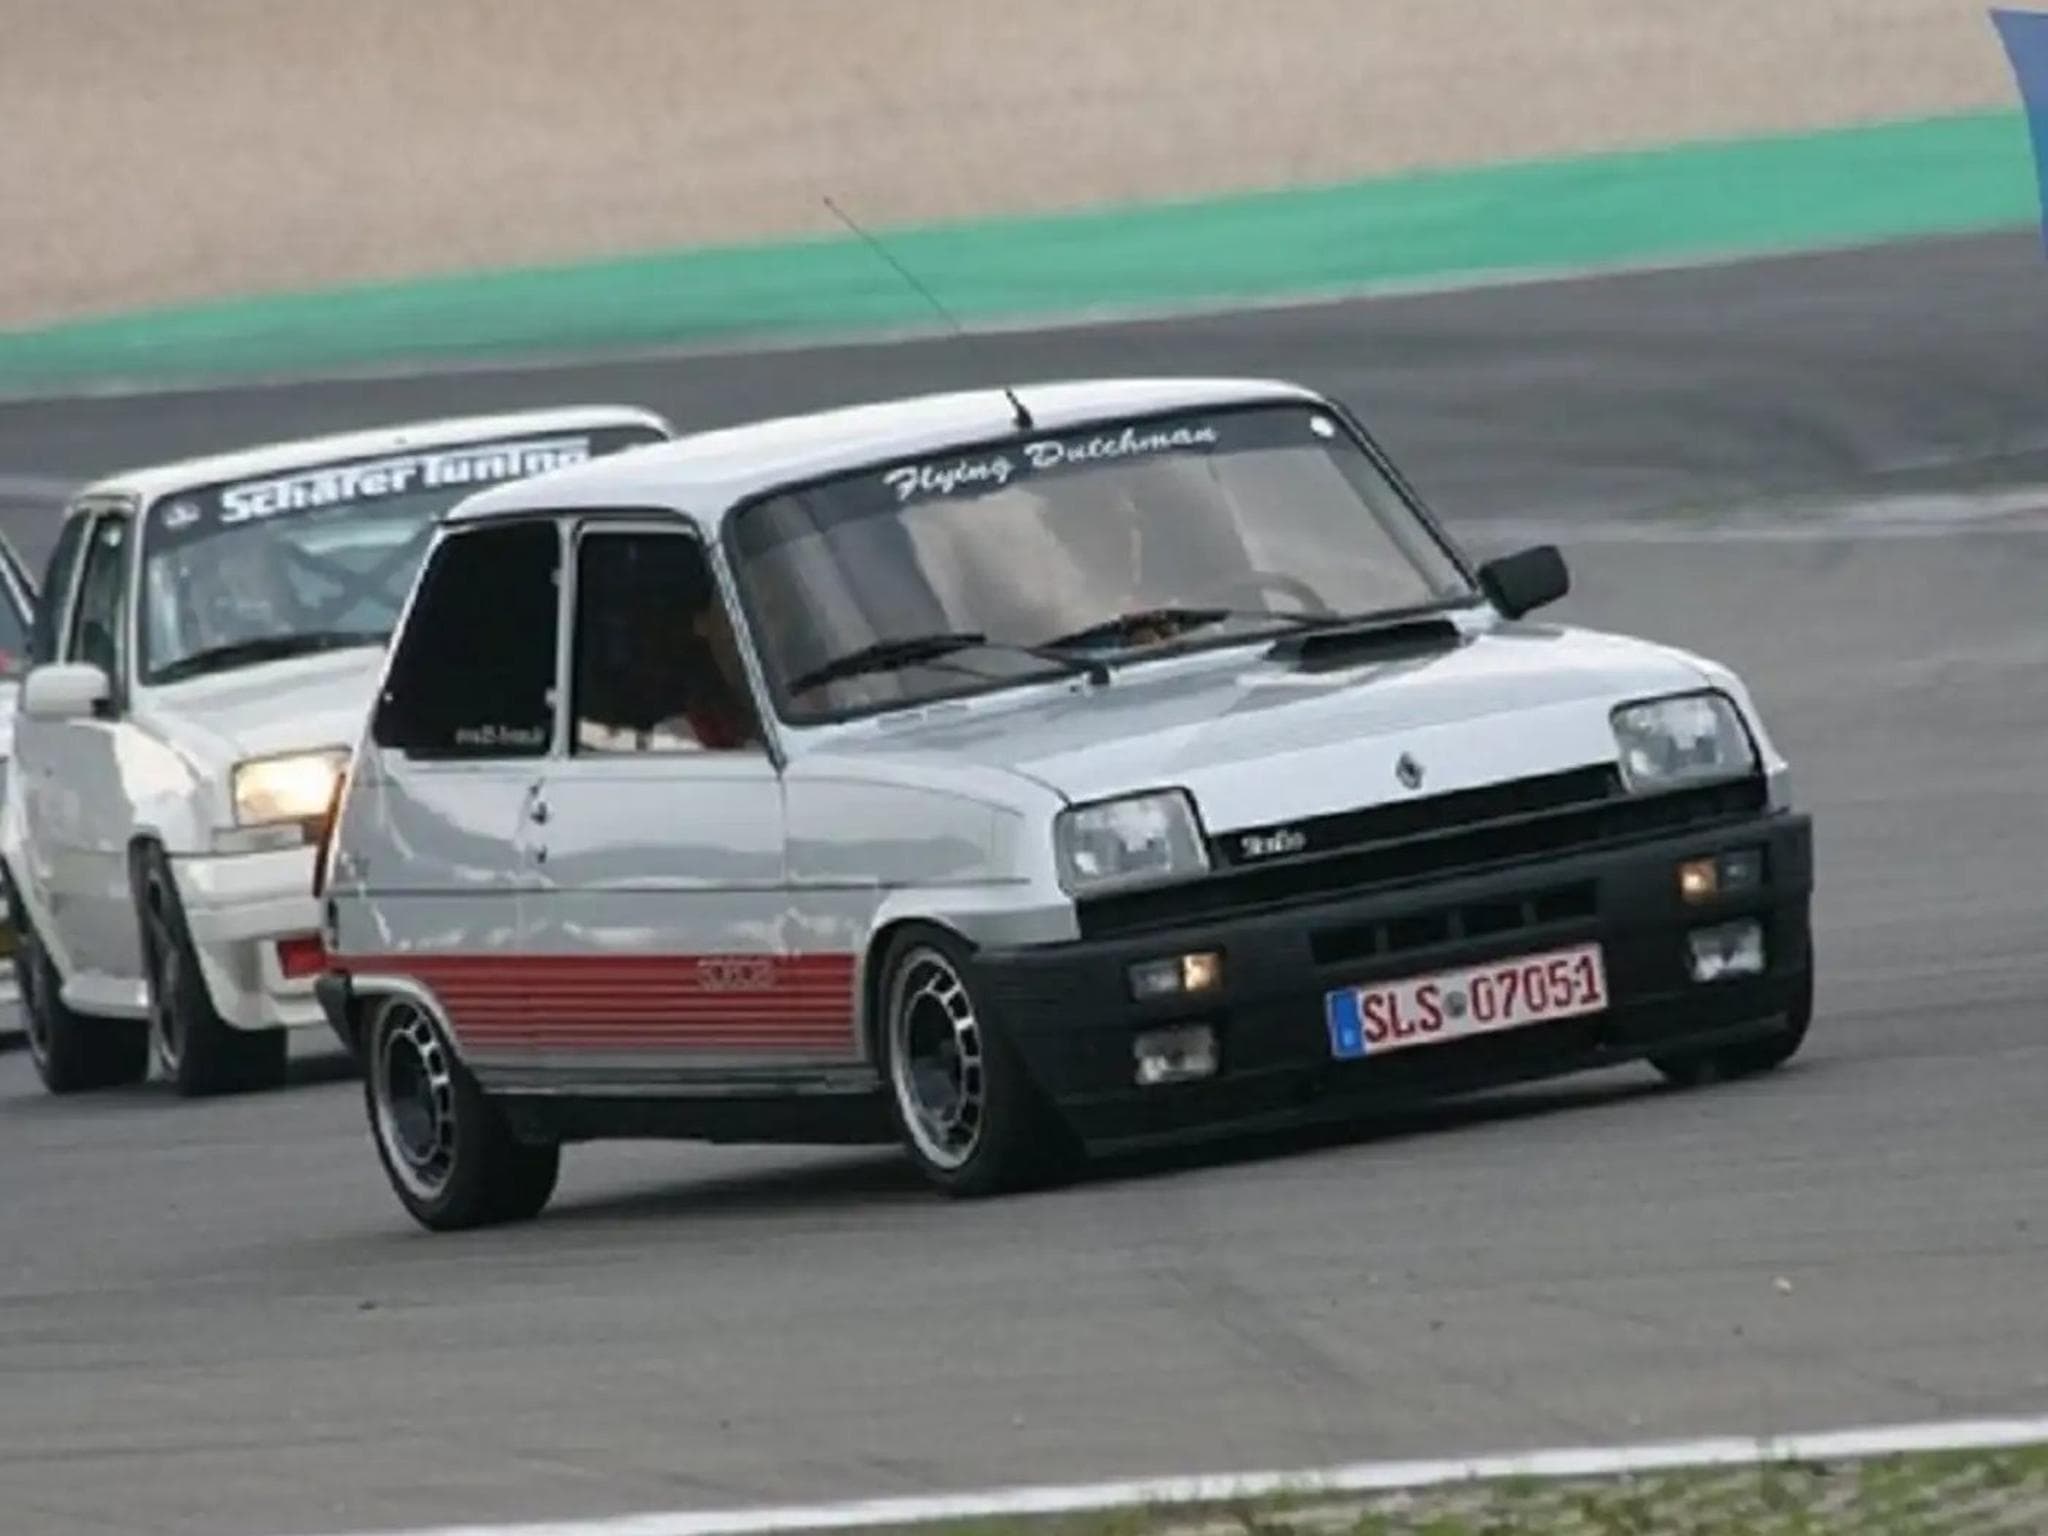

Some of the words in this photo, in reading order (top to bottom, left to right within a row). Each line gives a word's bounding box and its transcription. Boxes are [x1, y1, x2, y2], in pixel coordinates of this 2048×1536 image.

[883, 455, 1013, 500] Flying
[1024, 426, 1218, 468] Dutchman
[1362, 984, 1443, 1043] SLS
[1469, 954, 1601, 1023] 07051
